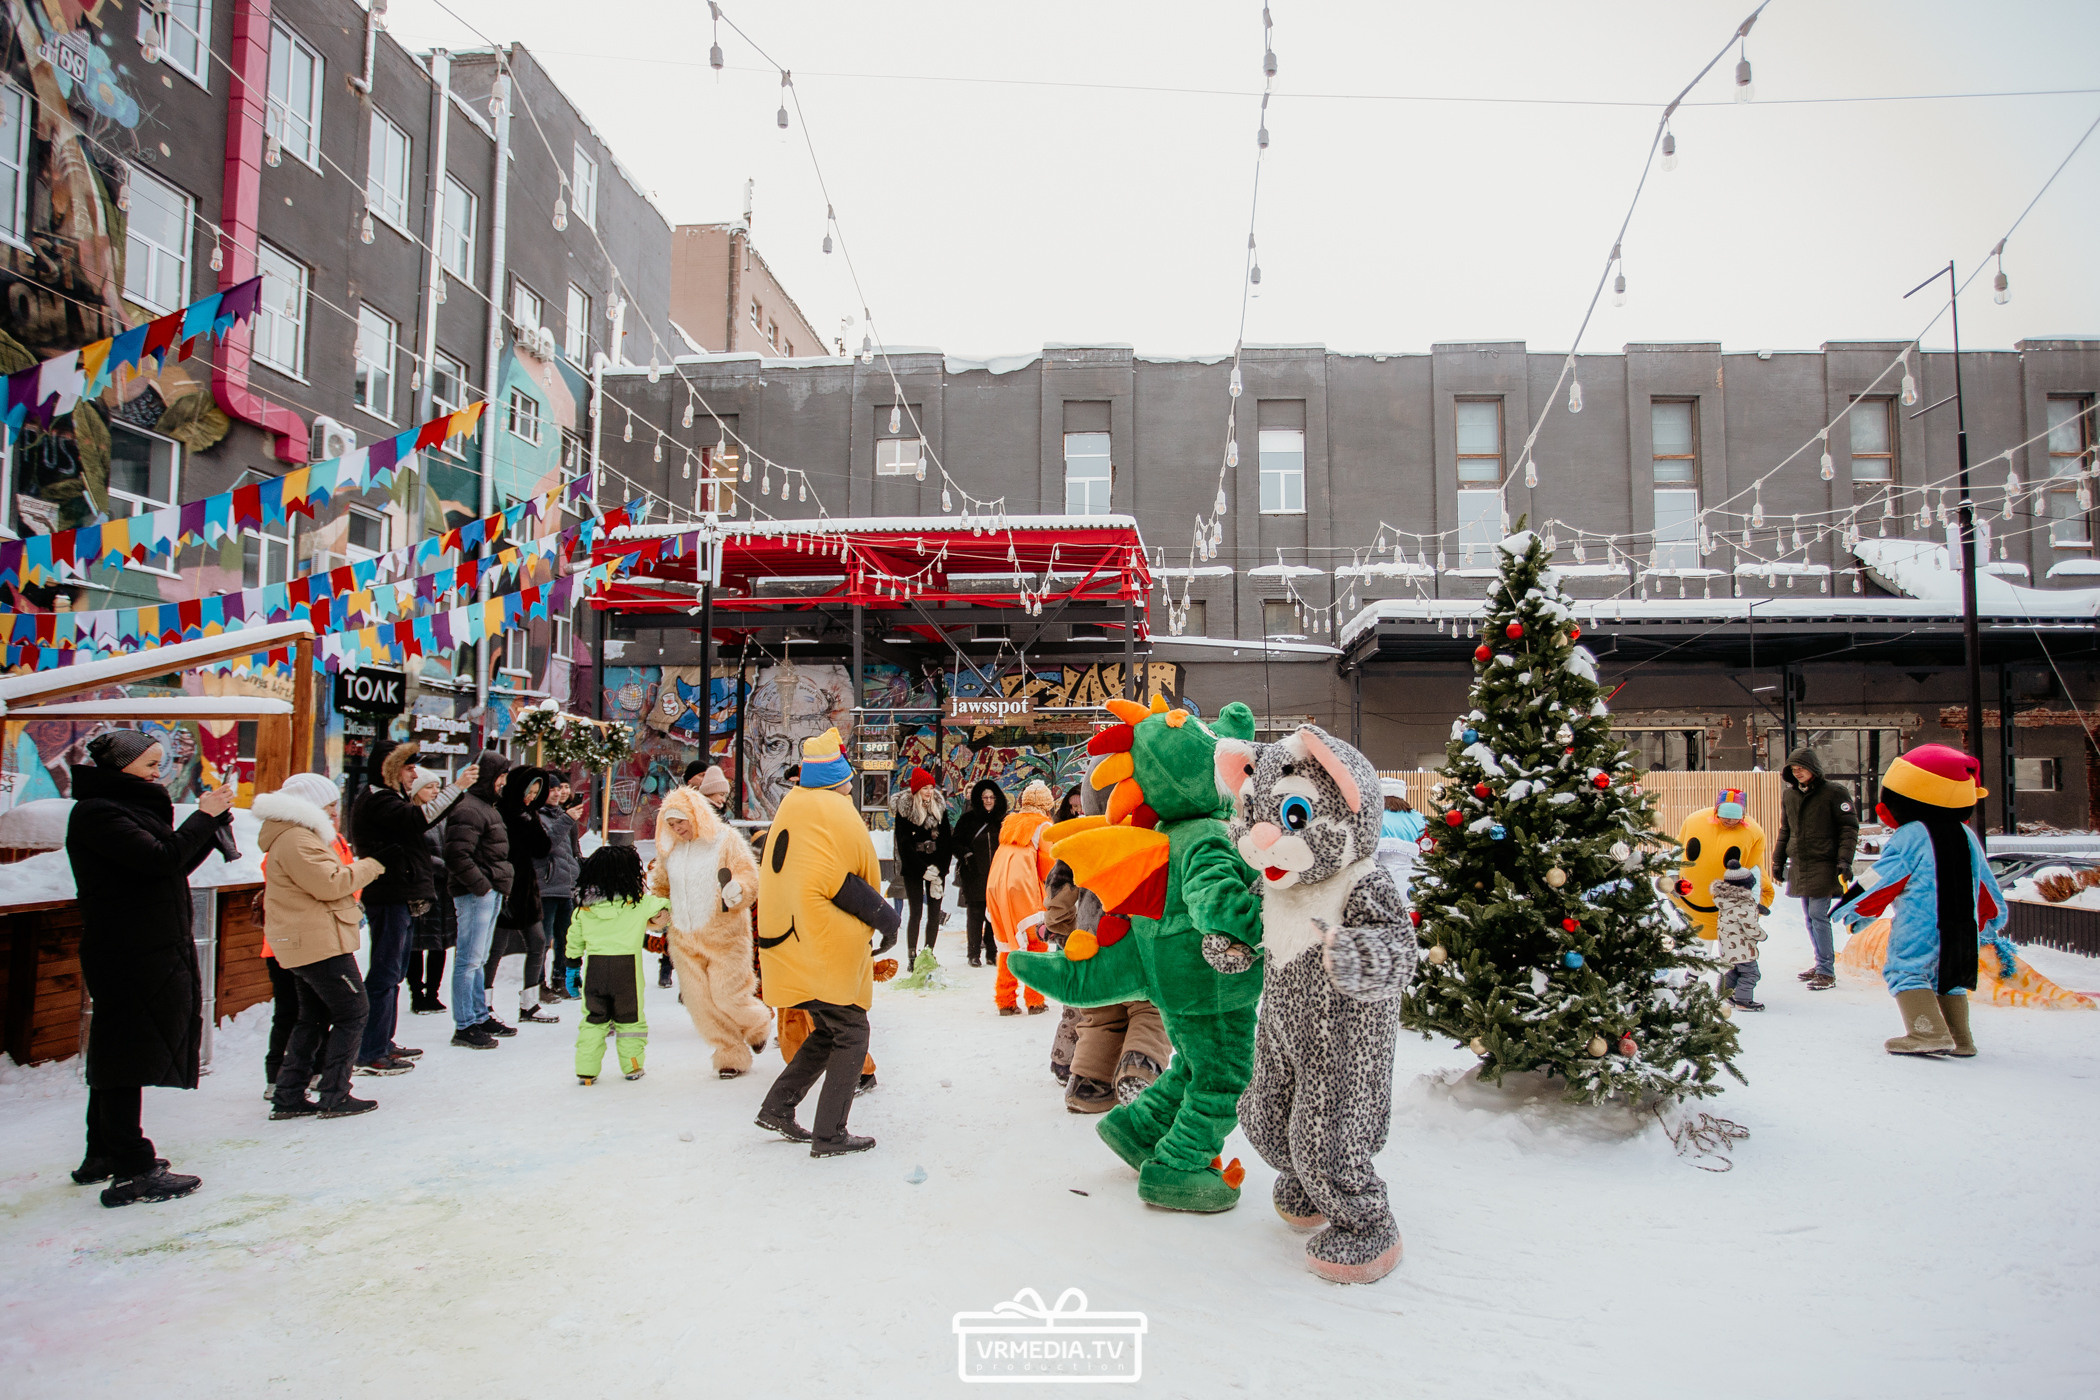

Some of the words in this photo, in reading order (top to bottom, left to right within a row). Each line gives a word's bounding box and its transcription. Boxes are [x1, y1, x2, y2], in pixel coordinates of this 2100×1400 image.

[950, 697, 1029, 718] jawsspot
[865, 743, 889, 752] SPOT
[864, 761, 893, 769] BEER
